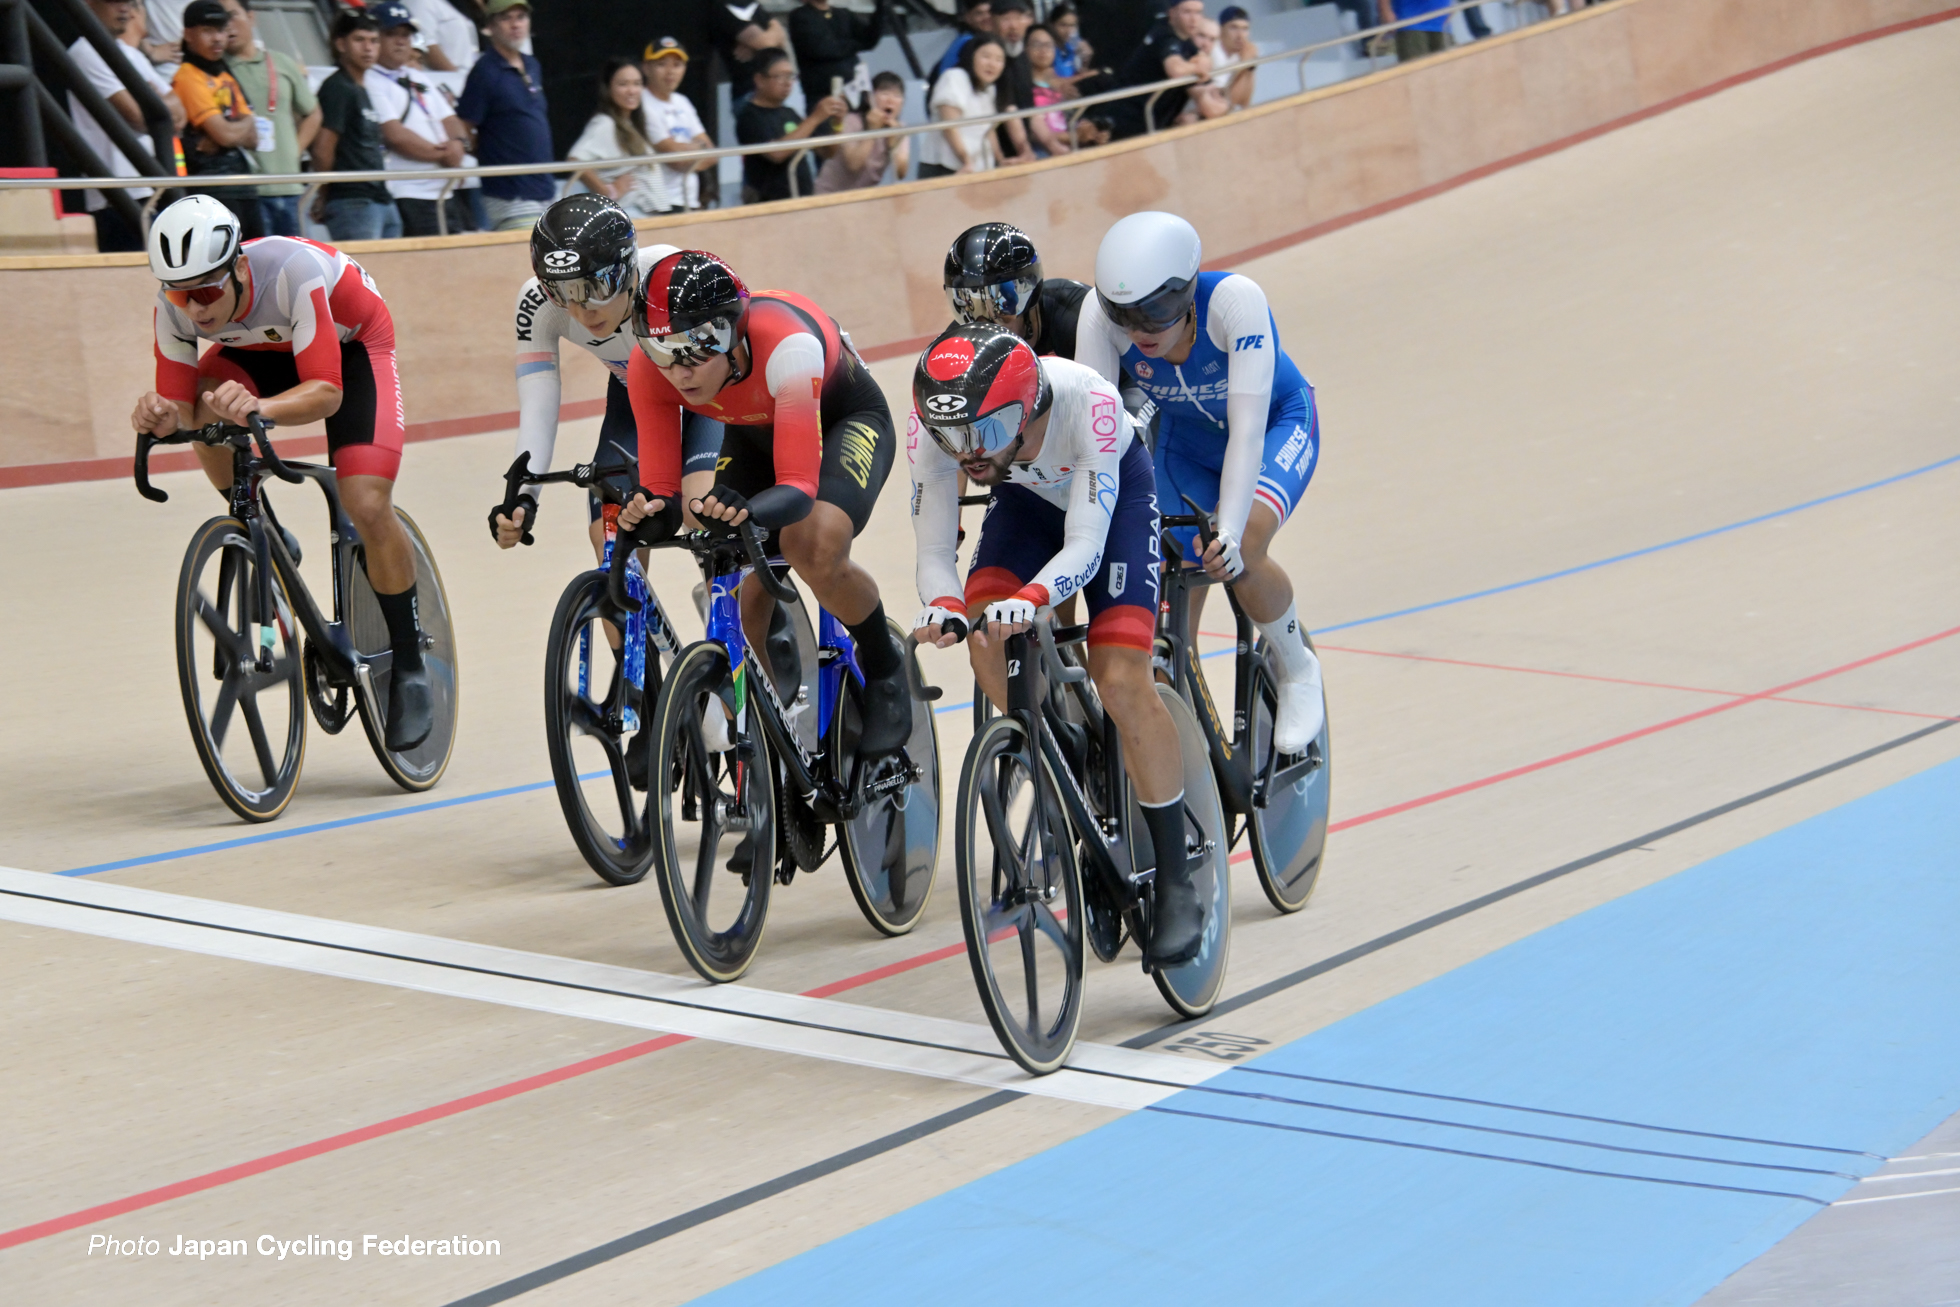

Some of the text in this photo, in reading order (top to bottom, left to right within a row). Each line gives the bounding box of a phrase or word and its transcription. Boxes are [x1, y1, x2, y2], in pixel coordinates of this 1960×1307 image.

[545, 266, 581, 274] Kabuto
[516, 284, 549, 341] KOREA
[649, 326, 672, 335] KASK
[1235, 335, 1264, 352] TPE
[931, 353, 969, 361] JAPAN
[1136, 379, 1228, 395] CHINES
[1153, 391, 1228, 402] TAIPE
[929, 412, 969, 420] Kabuto
[839, 421, 880, 489] CHINA
[1274, 424, 1308, 473] CHINESE
[1088, 470, 1096, 504] KEIRIN
[914, 482, 923, 516] KEIRIN
[1145, 494, 1161, 604] JAPAN
[1074, 552, 1101, 587] Cyclers
[874, 776, 905, 792] PINARELLO
[1163, 1031, 1272, 1060] 250
